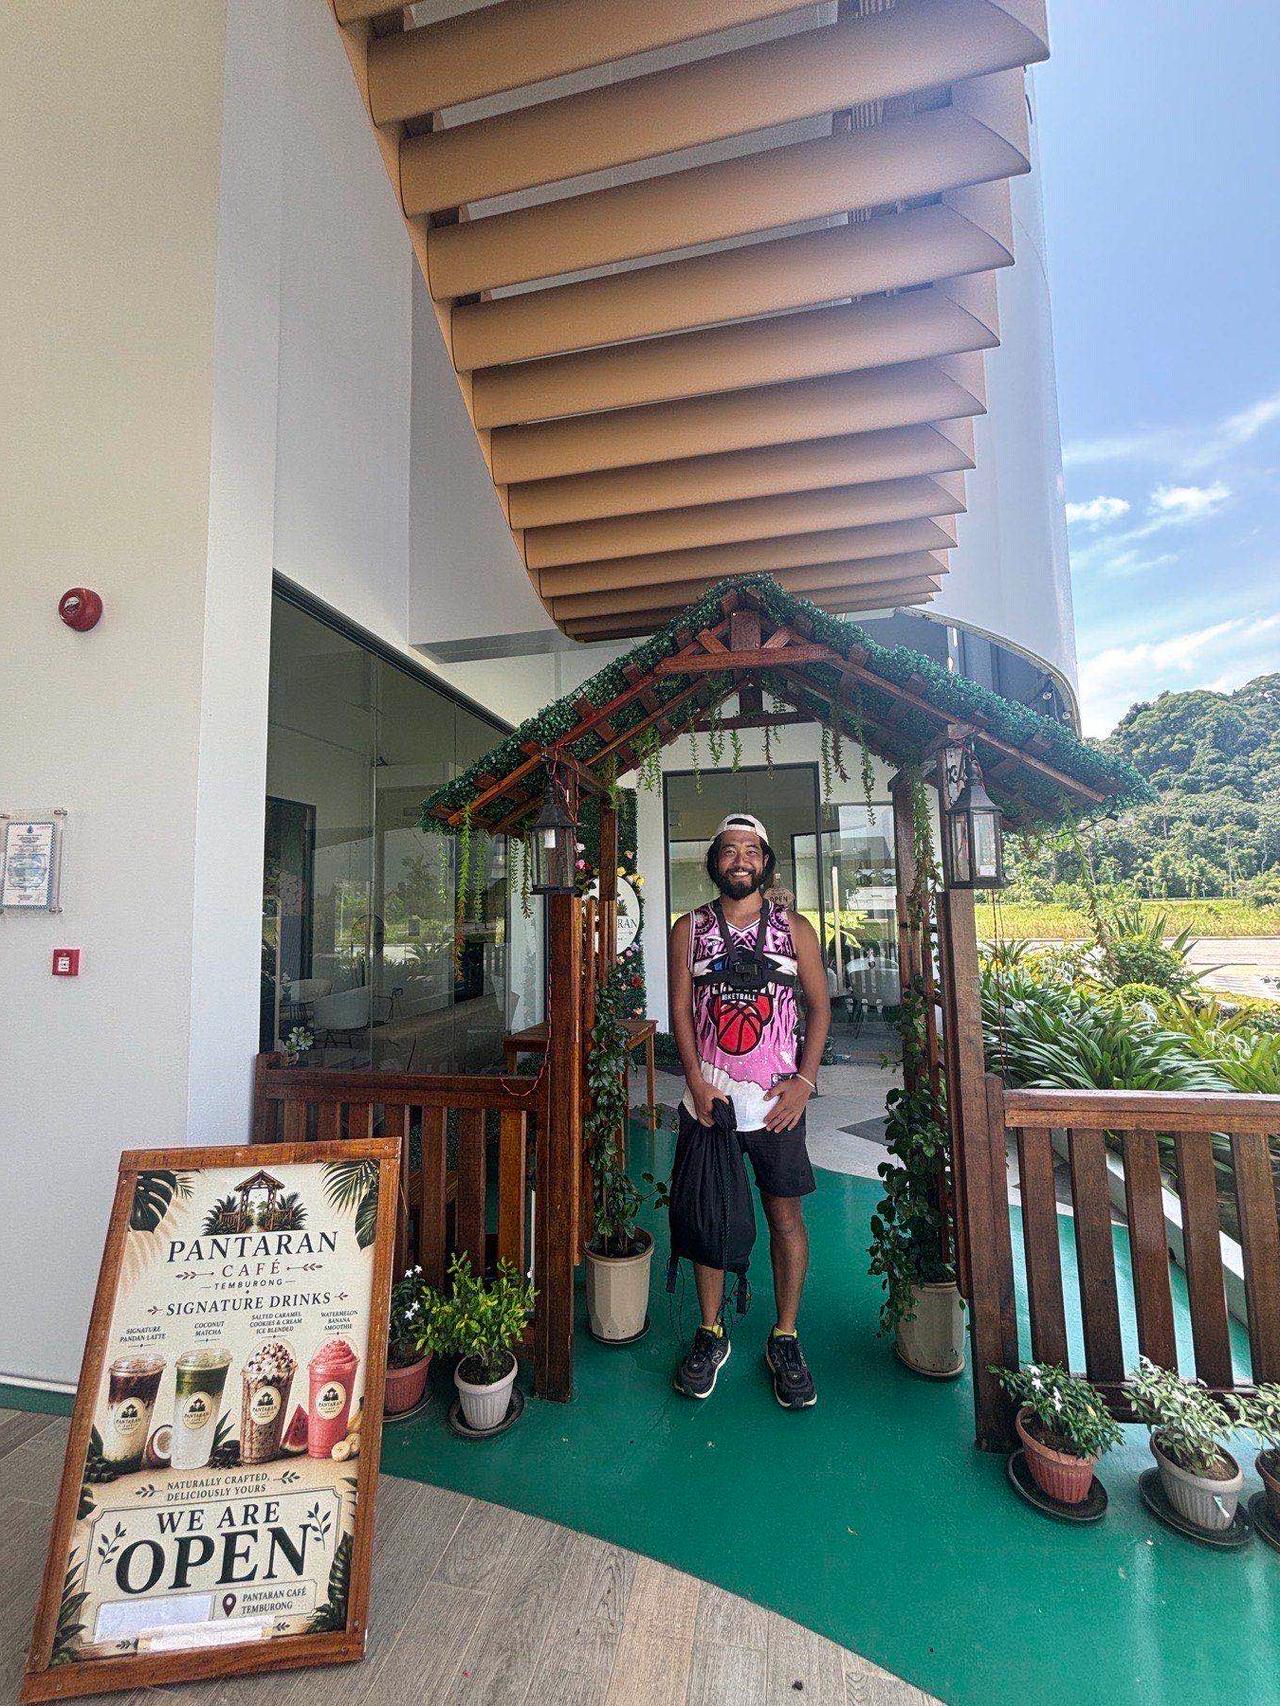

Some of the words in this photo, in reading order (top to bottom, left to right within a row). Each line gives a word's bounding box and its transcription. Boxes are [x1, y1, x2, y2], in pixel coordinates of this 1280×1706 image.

[721, 992, 757, 1001] SKETBALL
[167, 1231, 338, 1263] PANTARAN
[222, 1258, 281, 1278] CAFÉ
[214, 1278, 283, 1290] TEMBURONG
[166, 1296, 264, 1316] SIGNATURE
[270, 1292, 331, 1308] DRINKS
[126, 1326, 161, 1334] SIGNATURE
[194, 1321, 225, 1329] COCONUT
[249, 1320, 275, 1328] COOKIES
[324, 1323, 353, 1331] SMOOTHIE
[195, 1329, 222, 1337] MATCHA
[167, 1477, 222, 1490] NATURALLY
[224, 1473, 270, 1484] CRAFTED,
[167, 1487, 232, 1502] DELICIOUSLY
[234, 1484, 266, 1495] YOURS
[156, 1509, 205, 1534] WE
[217, 1501, 280, 1529] ARE
[116, 1523, 311, 1594] OPEN
[242, 1589, 284, 1602] PANTARAN
[285, 1585, 307, 1598] CAFÉ
[241, 1601, 293, 1615] TEMBURONG
